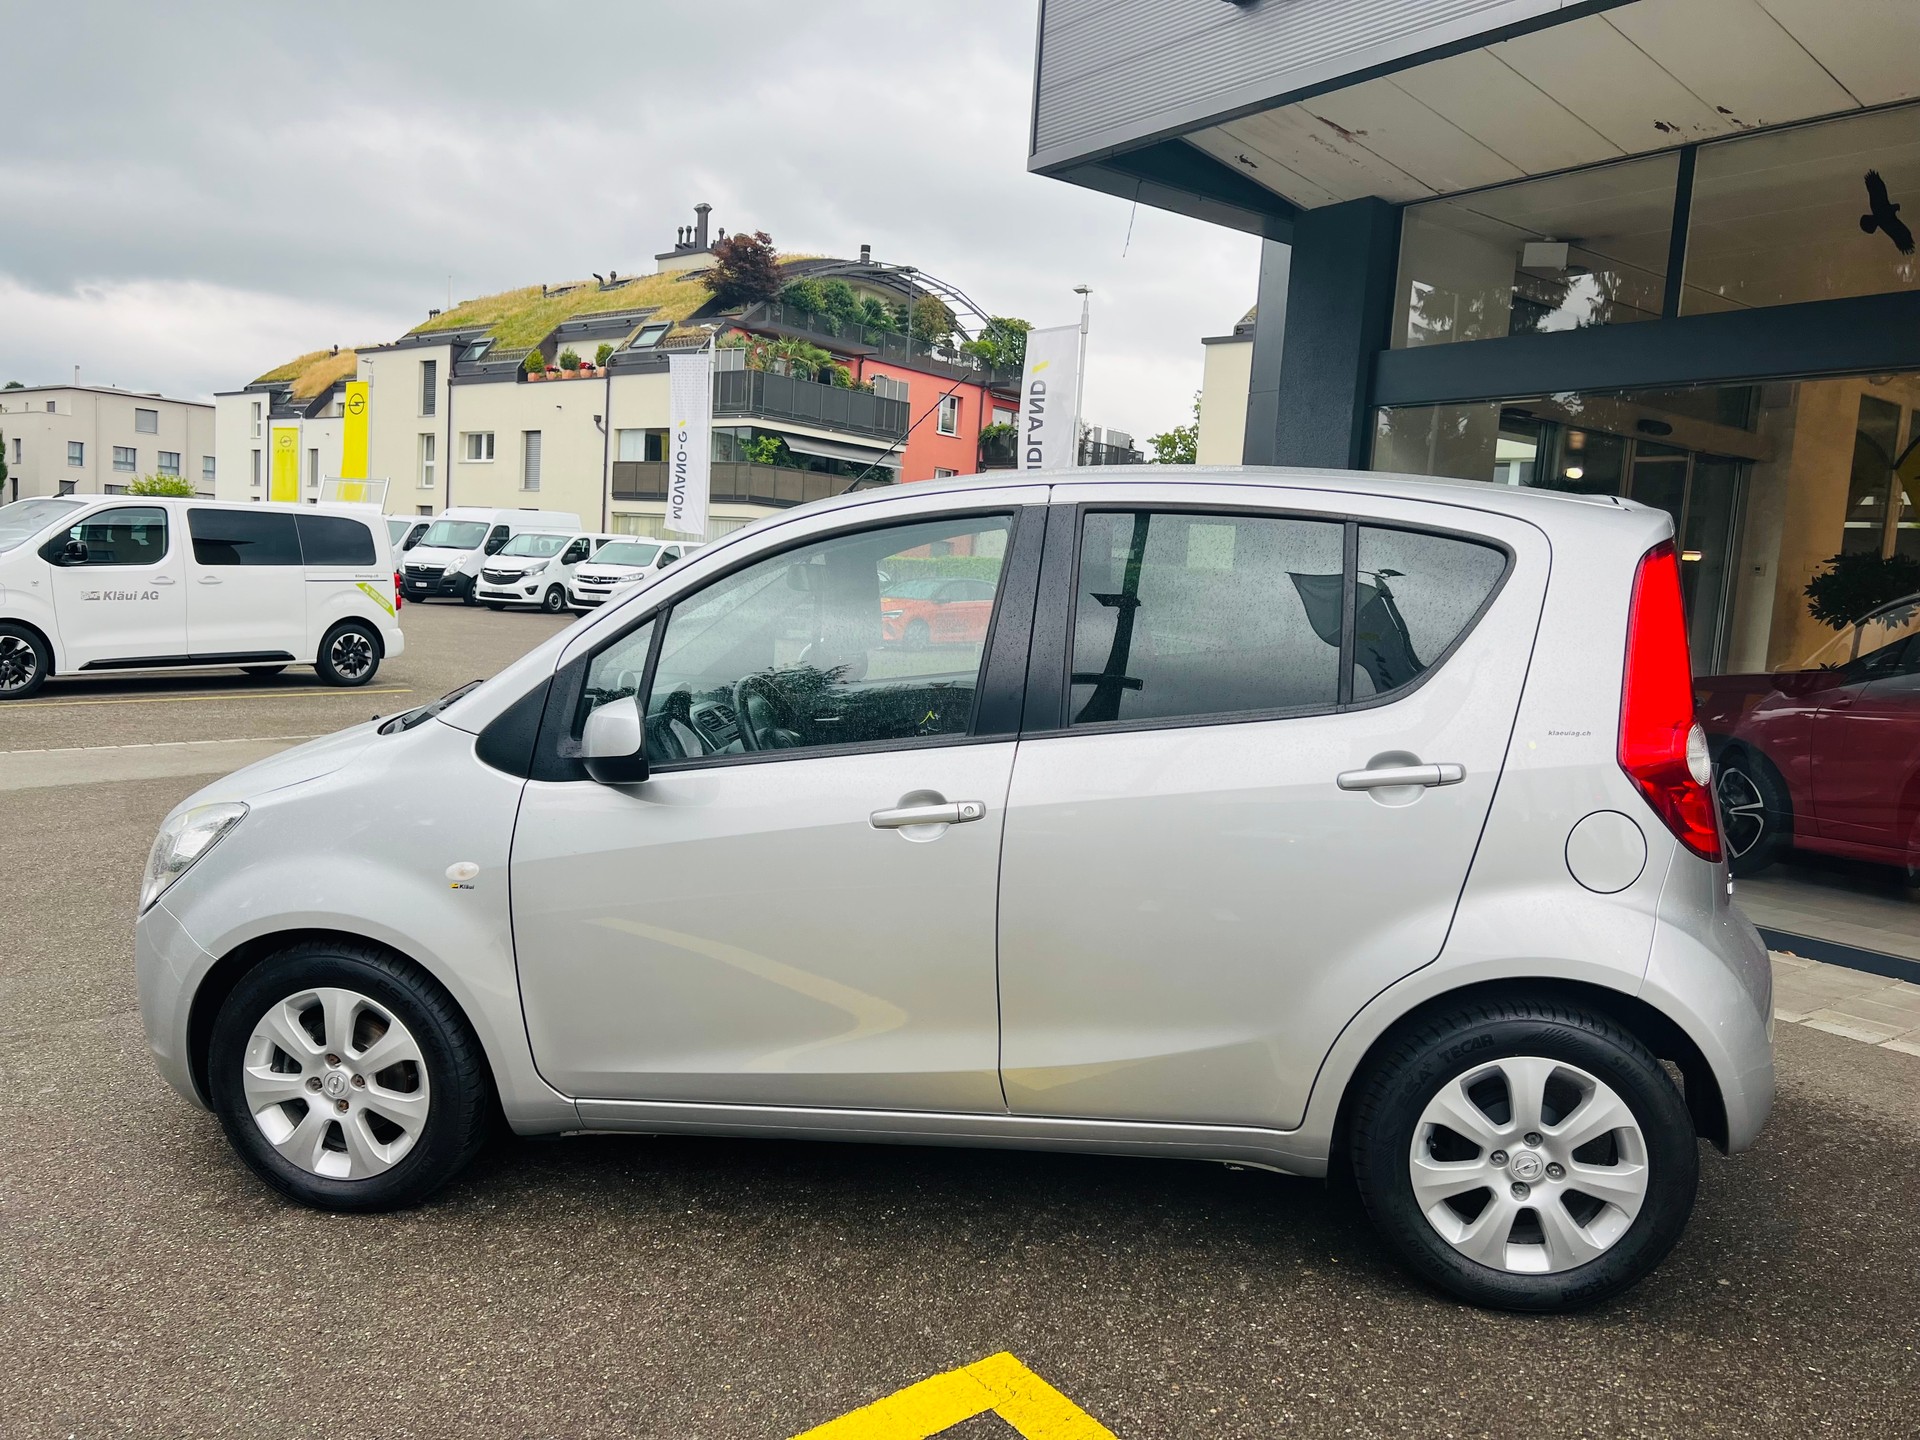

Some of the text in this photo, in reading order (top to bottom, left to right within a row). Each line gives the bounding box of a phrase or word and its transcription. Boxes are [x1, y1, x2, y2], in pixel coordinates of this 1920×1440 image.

[103, 591, 159, 601] Kläui AG
[1437, 1034, 1495, 1063] TECAR
